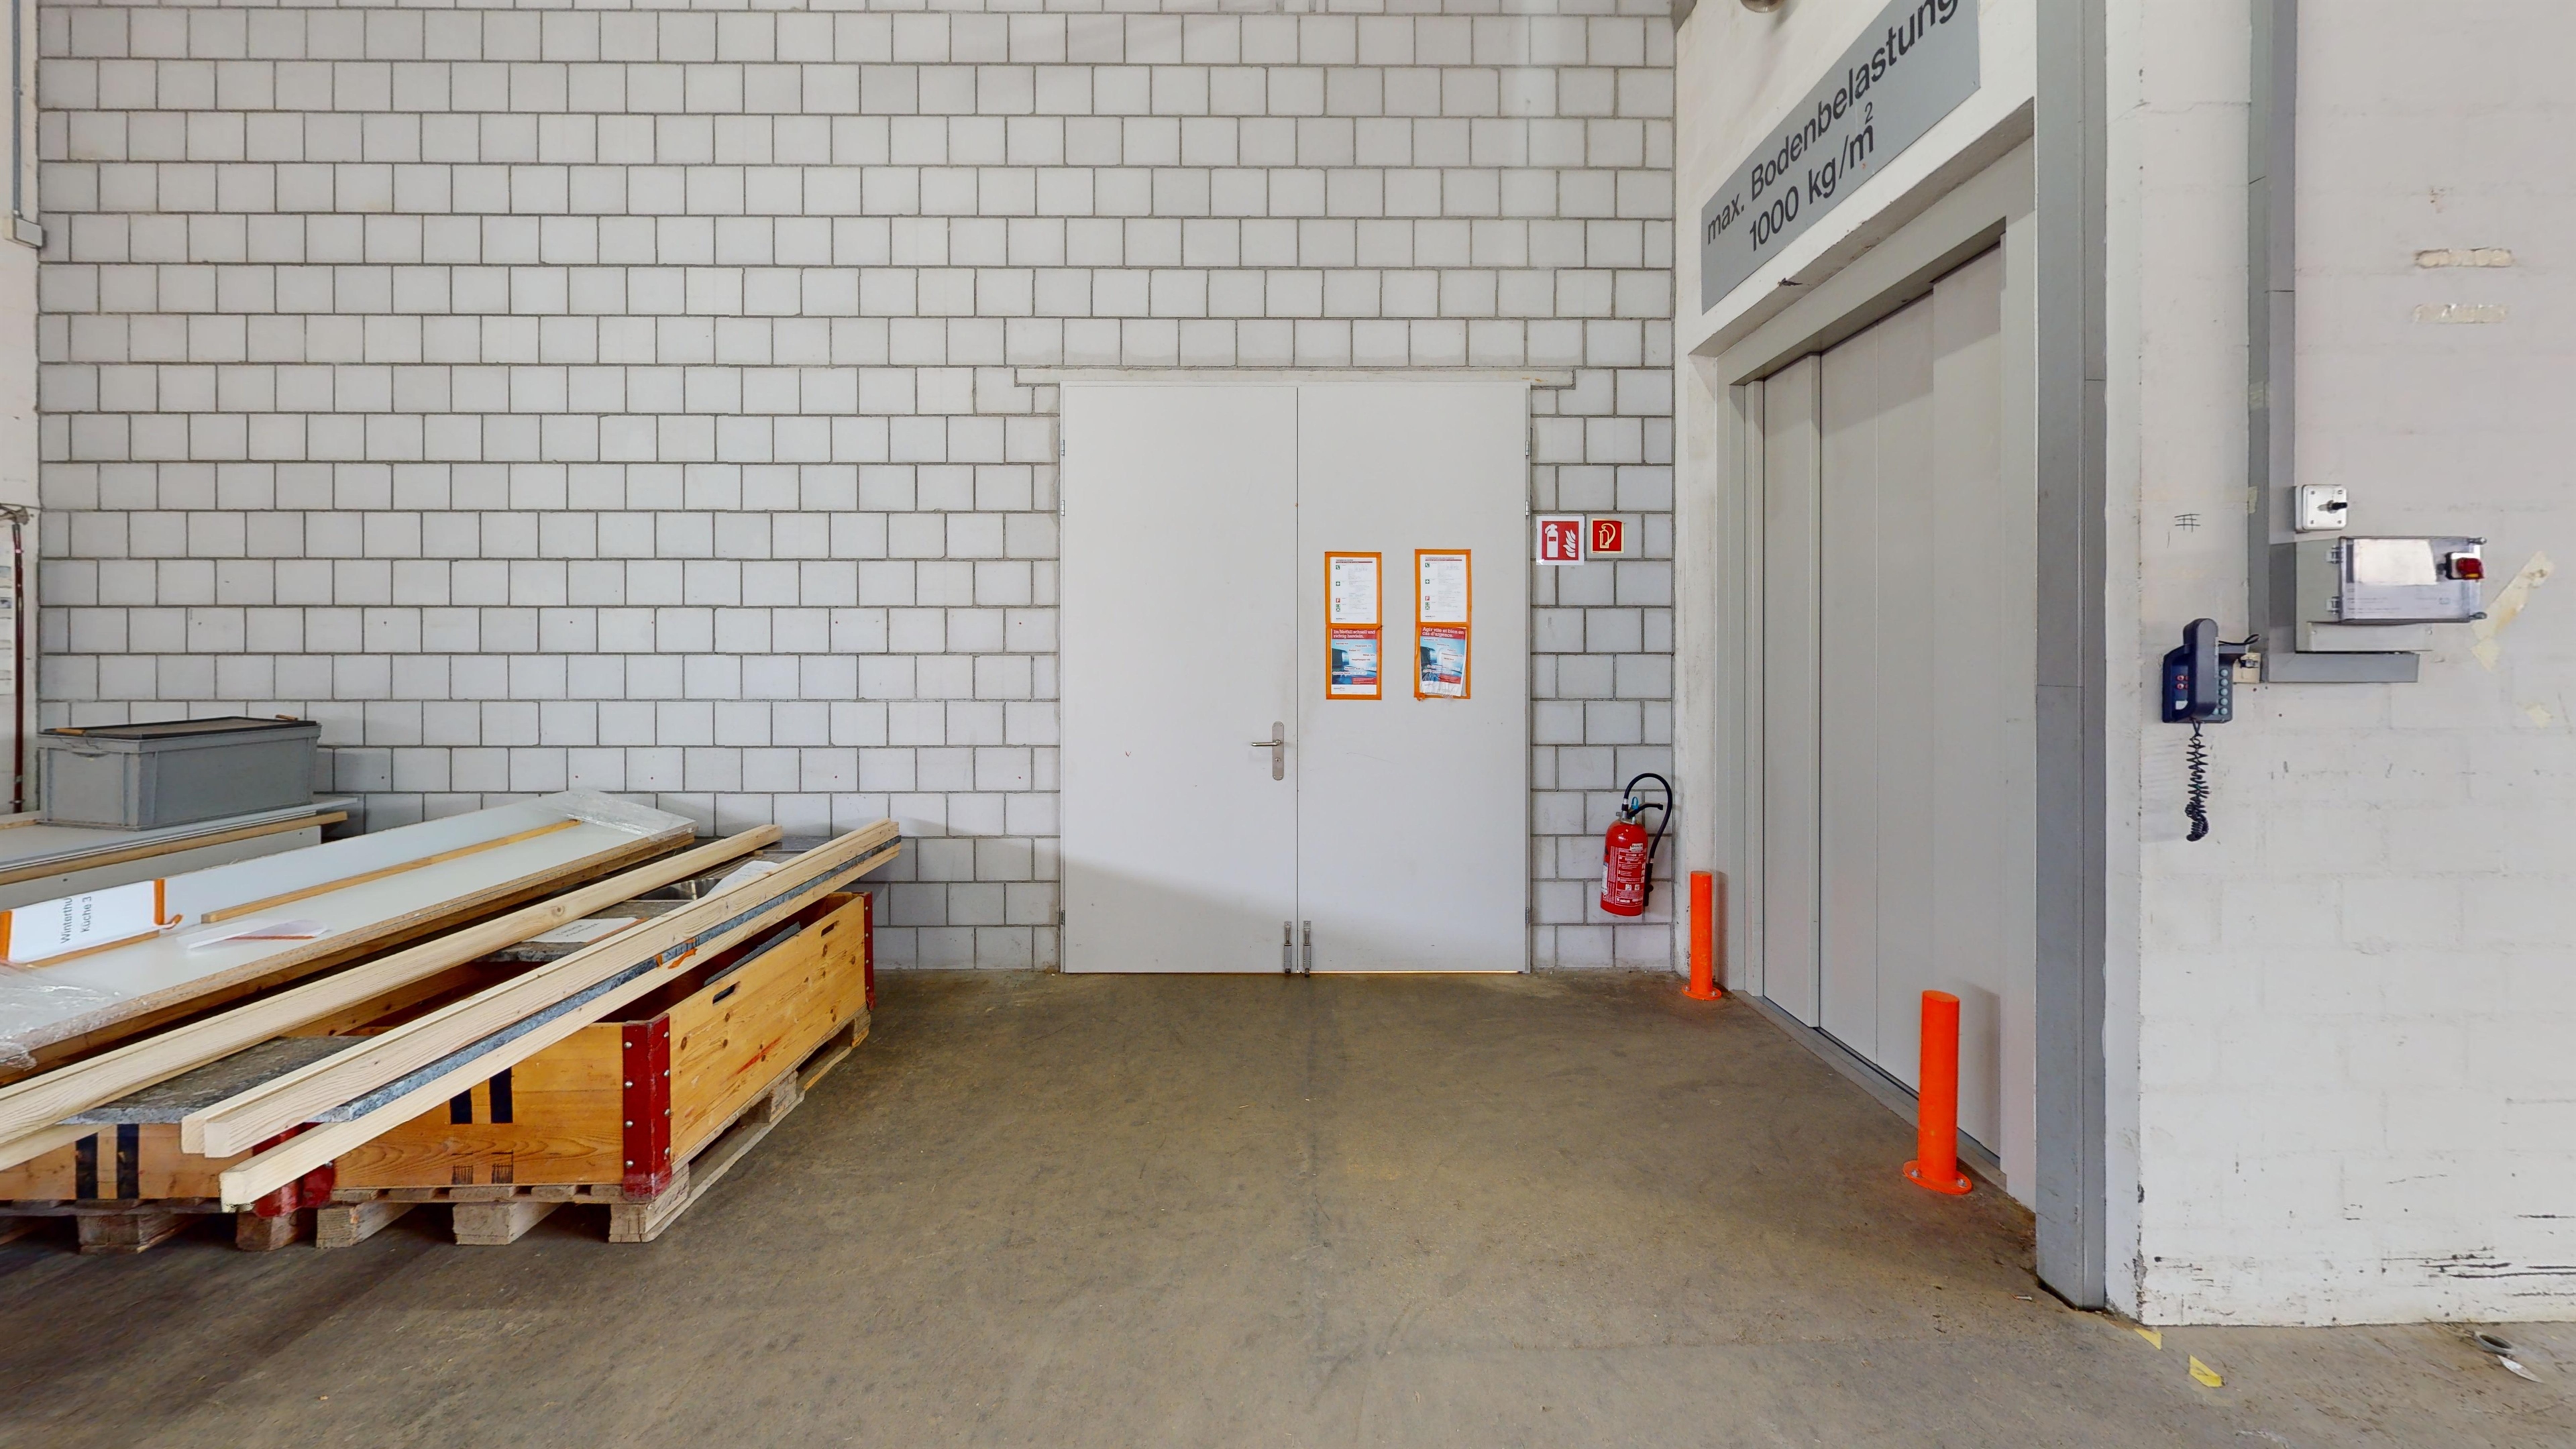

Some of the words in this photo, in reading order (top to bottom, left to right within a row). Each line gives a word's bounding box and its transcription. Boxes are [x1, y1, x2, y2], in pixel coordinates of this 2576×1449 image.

[1707, 193, 1746, 245] max.
[1752, 0, 1958, 202] Bodenbelastung
[1750, 186, 1800, 252] 1000
